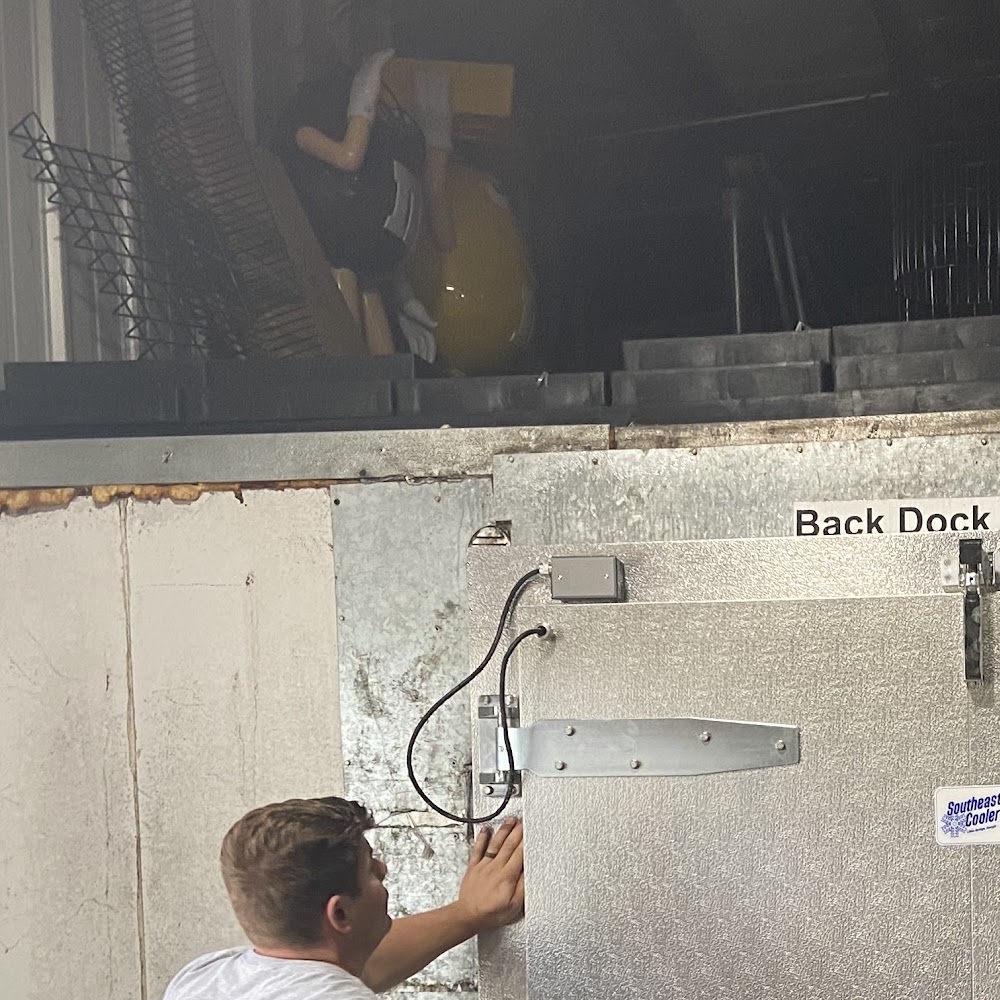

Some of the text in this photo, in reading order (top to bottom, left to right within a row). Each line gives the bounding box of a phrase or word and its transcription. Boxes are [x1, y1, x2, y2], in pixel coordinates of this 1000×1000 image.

[796, 507, 885, 537] Back
[899, 505, 991, 533] Dock
[965, 808, 1000, 828] Cooler
